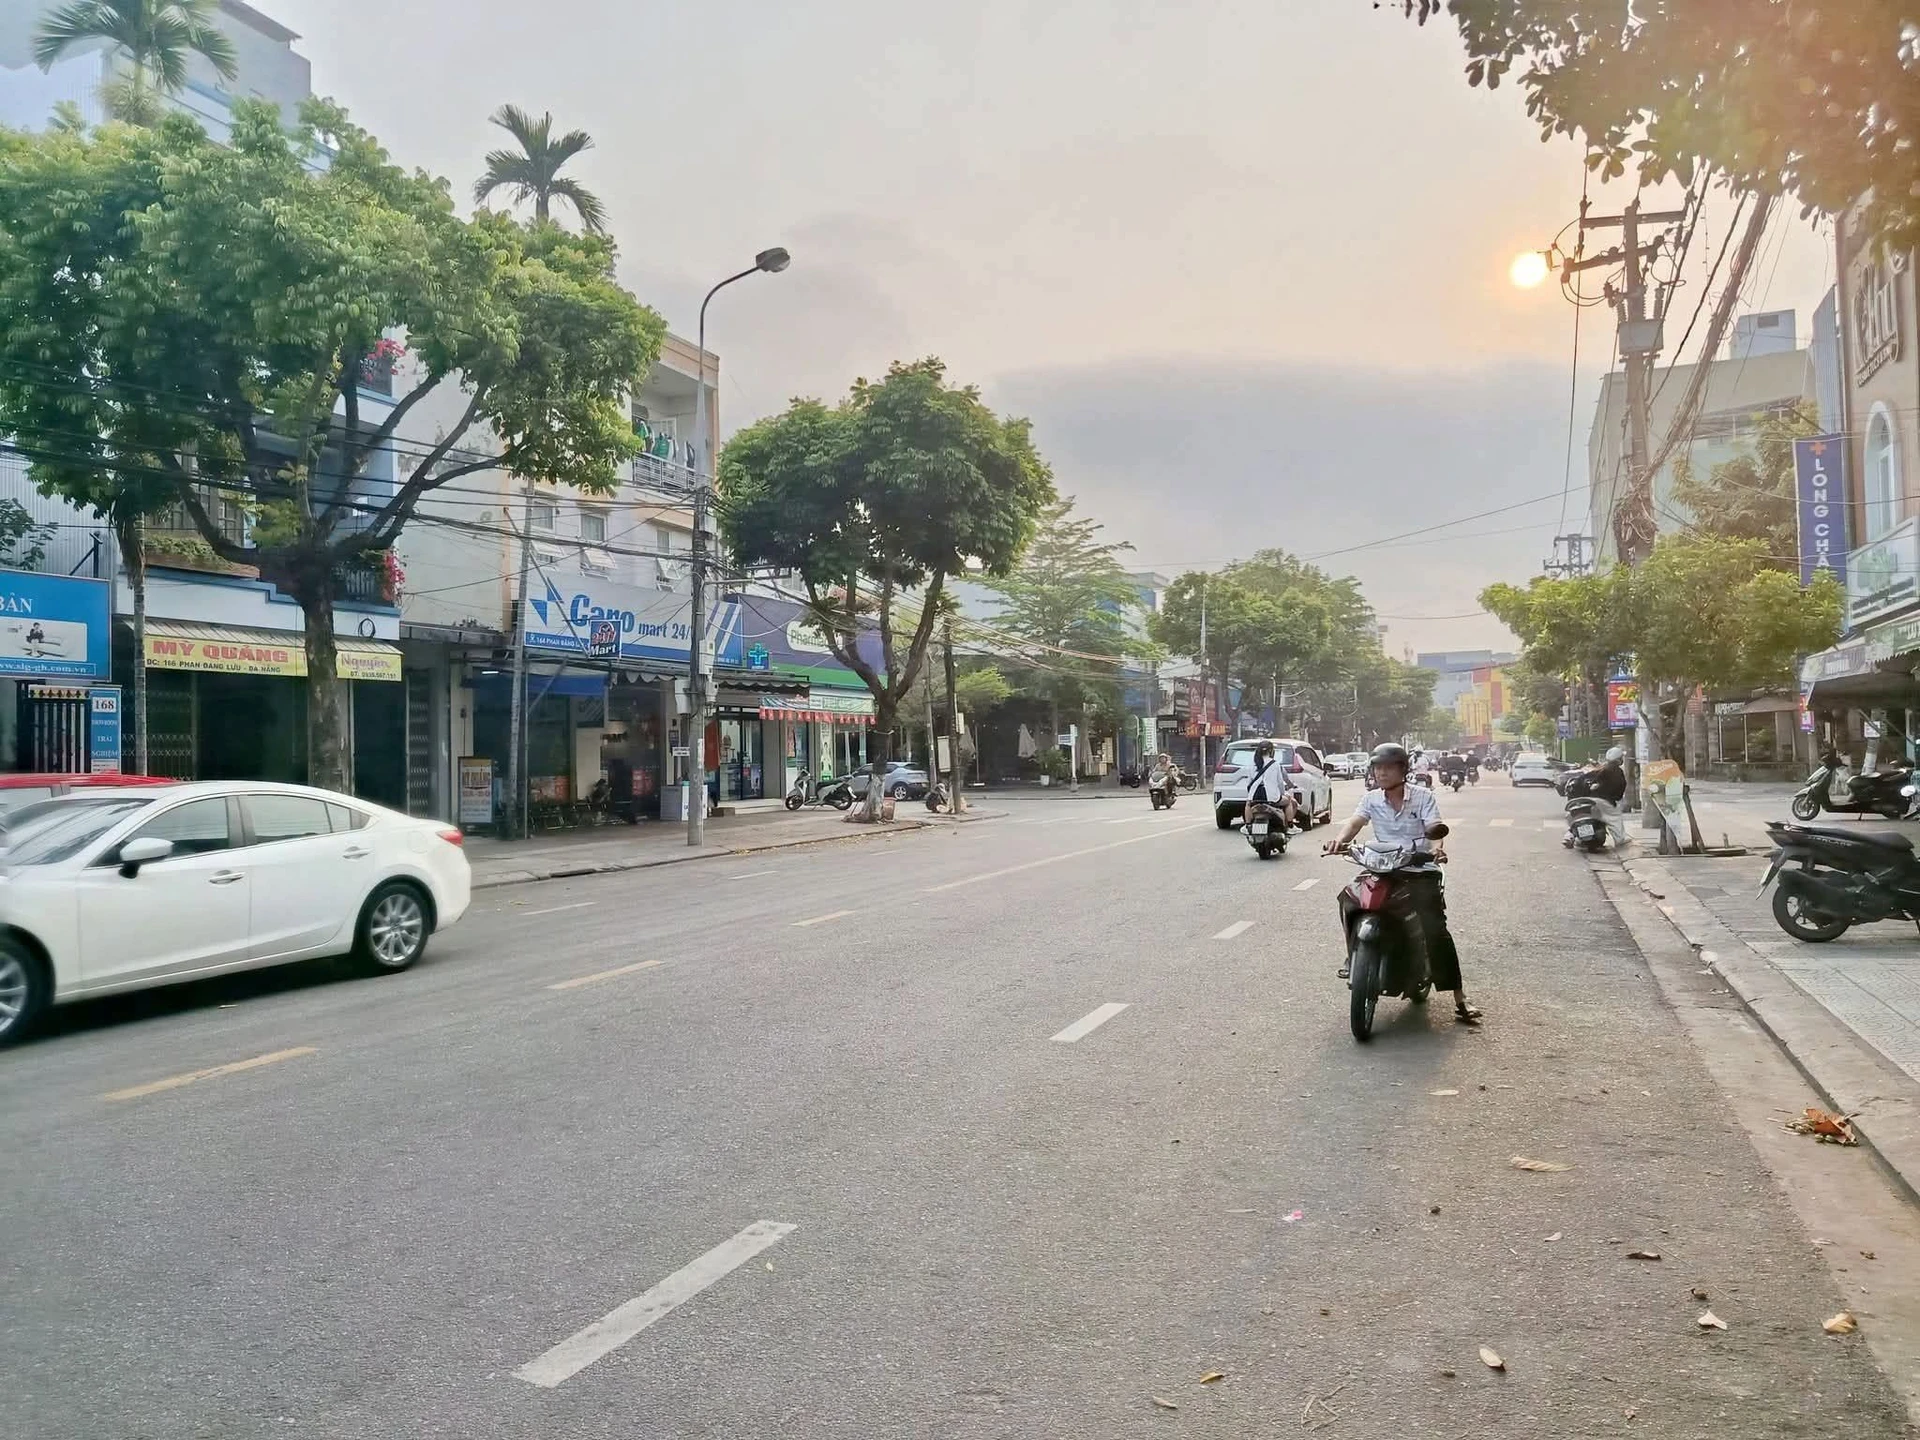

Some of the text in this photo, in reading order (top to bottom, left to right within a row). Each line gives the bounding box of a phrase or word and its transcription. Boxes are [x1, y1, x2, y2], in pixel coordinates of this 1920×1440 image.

[1812, 458, 1830, 568] LONG CHÂ
[638, 622, 668, 638] mart
[671, 623, 691, 641] 24/
[95, 700, 114, 710] 168
